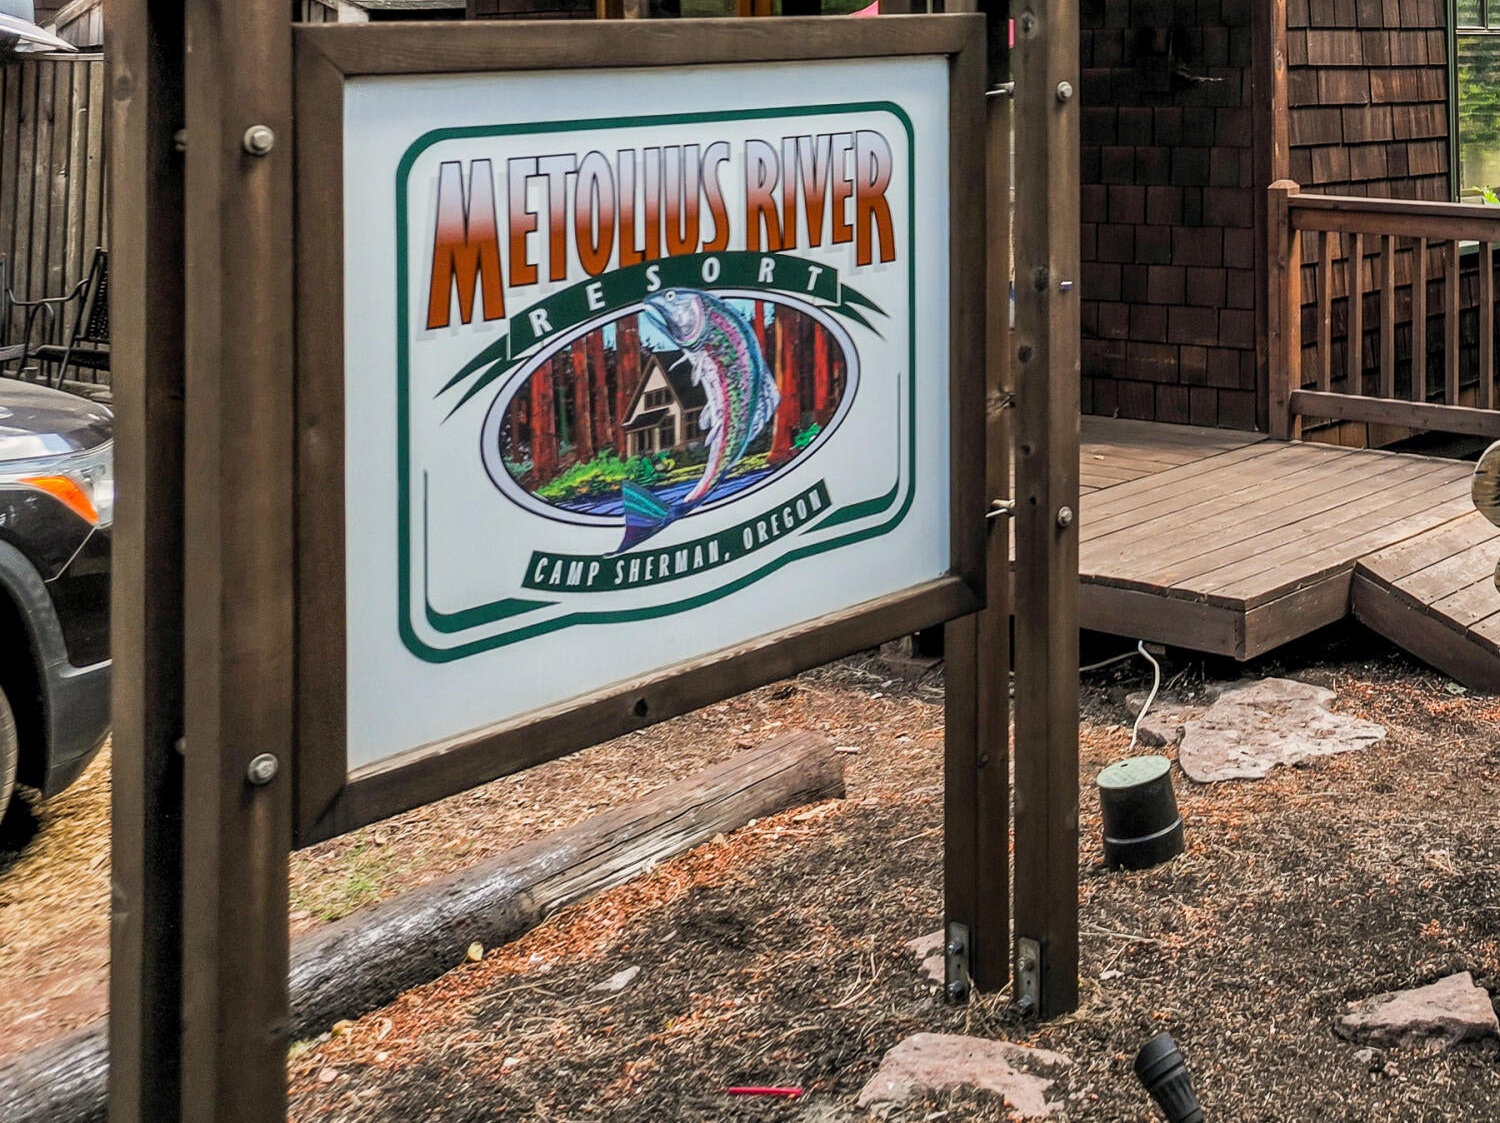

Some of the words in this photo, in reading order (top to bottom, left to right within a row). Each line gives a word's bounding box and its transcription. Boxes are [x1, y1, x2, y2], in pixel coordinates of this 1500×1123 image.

[425, 139, 731, 330] METOLIUS
[744, 129, 896, 266] RIVER
[528, 255, 823, 338] RESORT
[533, 556, 601, 586] CAMP
[614, 540, 731, 585] SHERMAN,
[742, 488, 823, 550] OREGON
